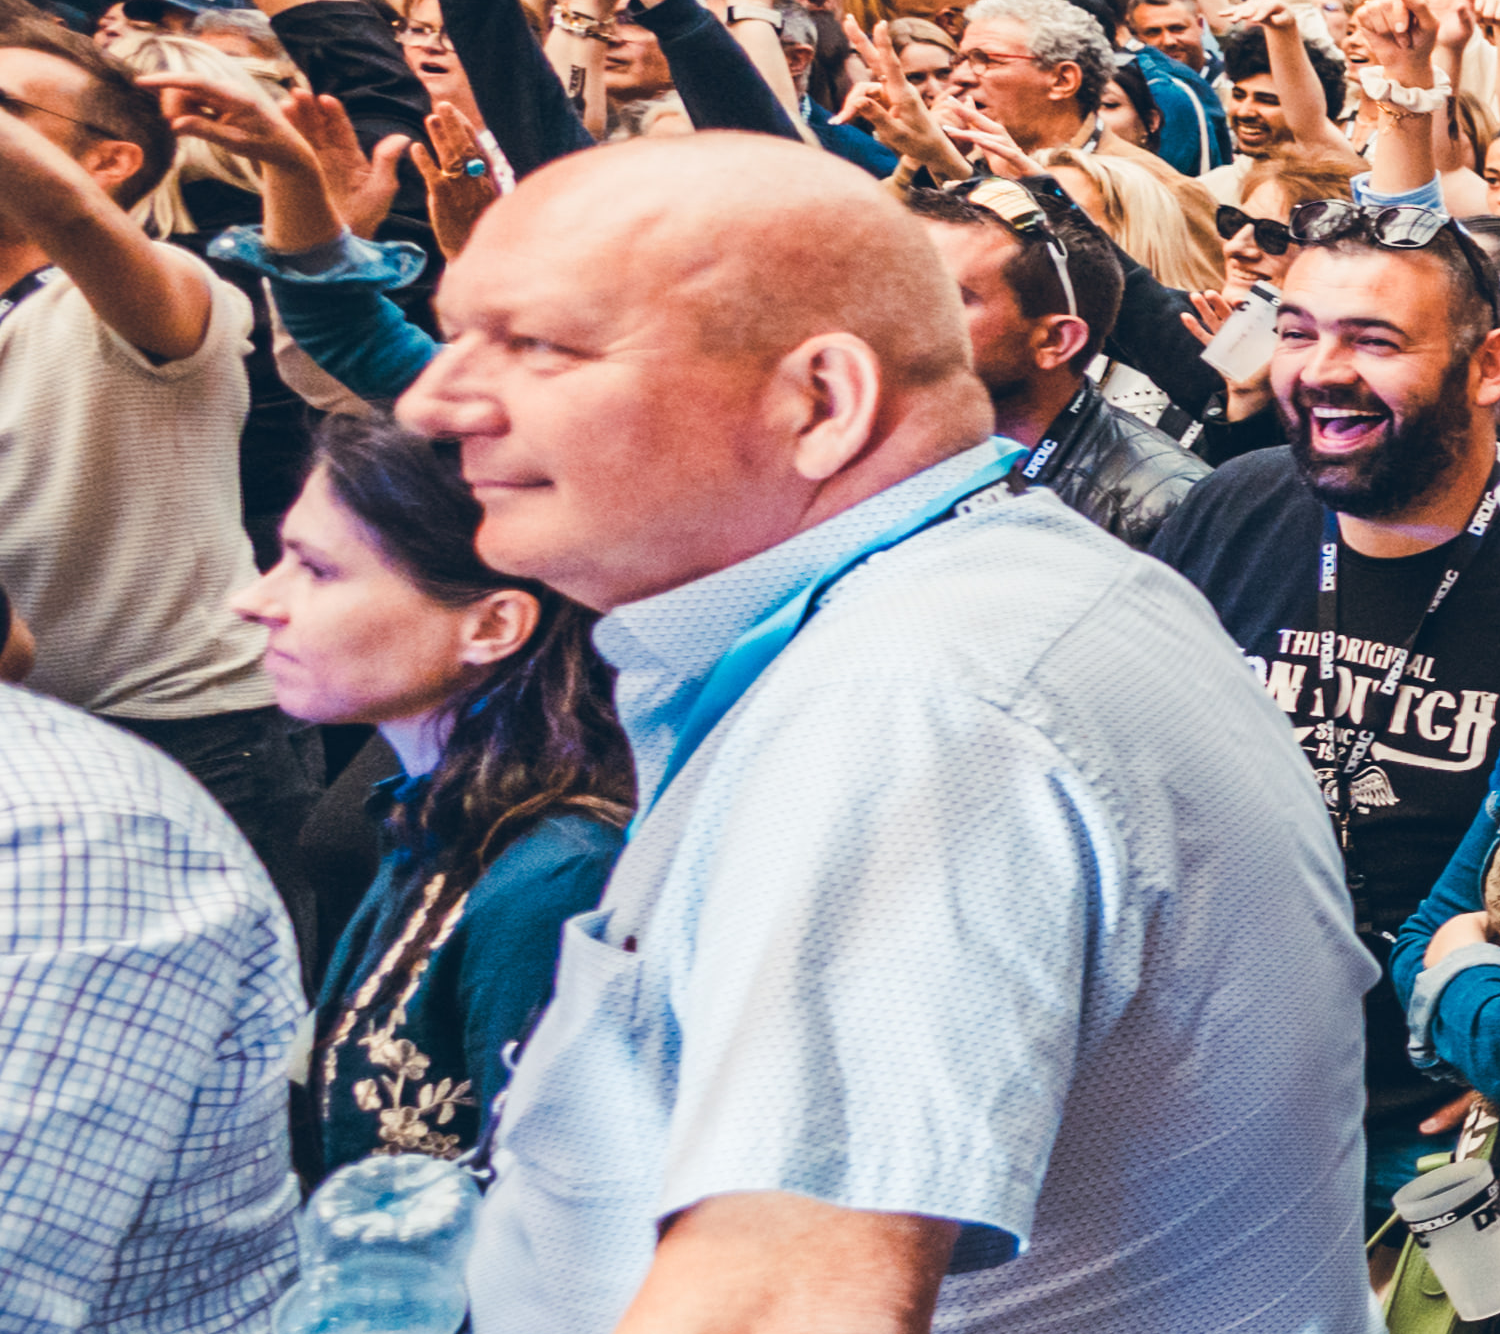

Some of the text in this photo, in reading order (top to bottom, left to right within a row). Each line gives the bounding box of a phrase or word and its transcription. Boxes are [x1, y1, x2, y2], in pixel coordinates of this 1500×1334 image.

[1022, 439, 1058, 479] DRDLC
[1466, 491, 1497, 537] DRDLC
[1320, 542, 1337, 593] DRDLC
[1320, 630, 1335, 680] DRDLC
[1379, 648, 1408, 696] DRDLC
[1344, 730, 1375, 773] DRDLC
